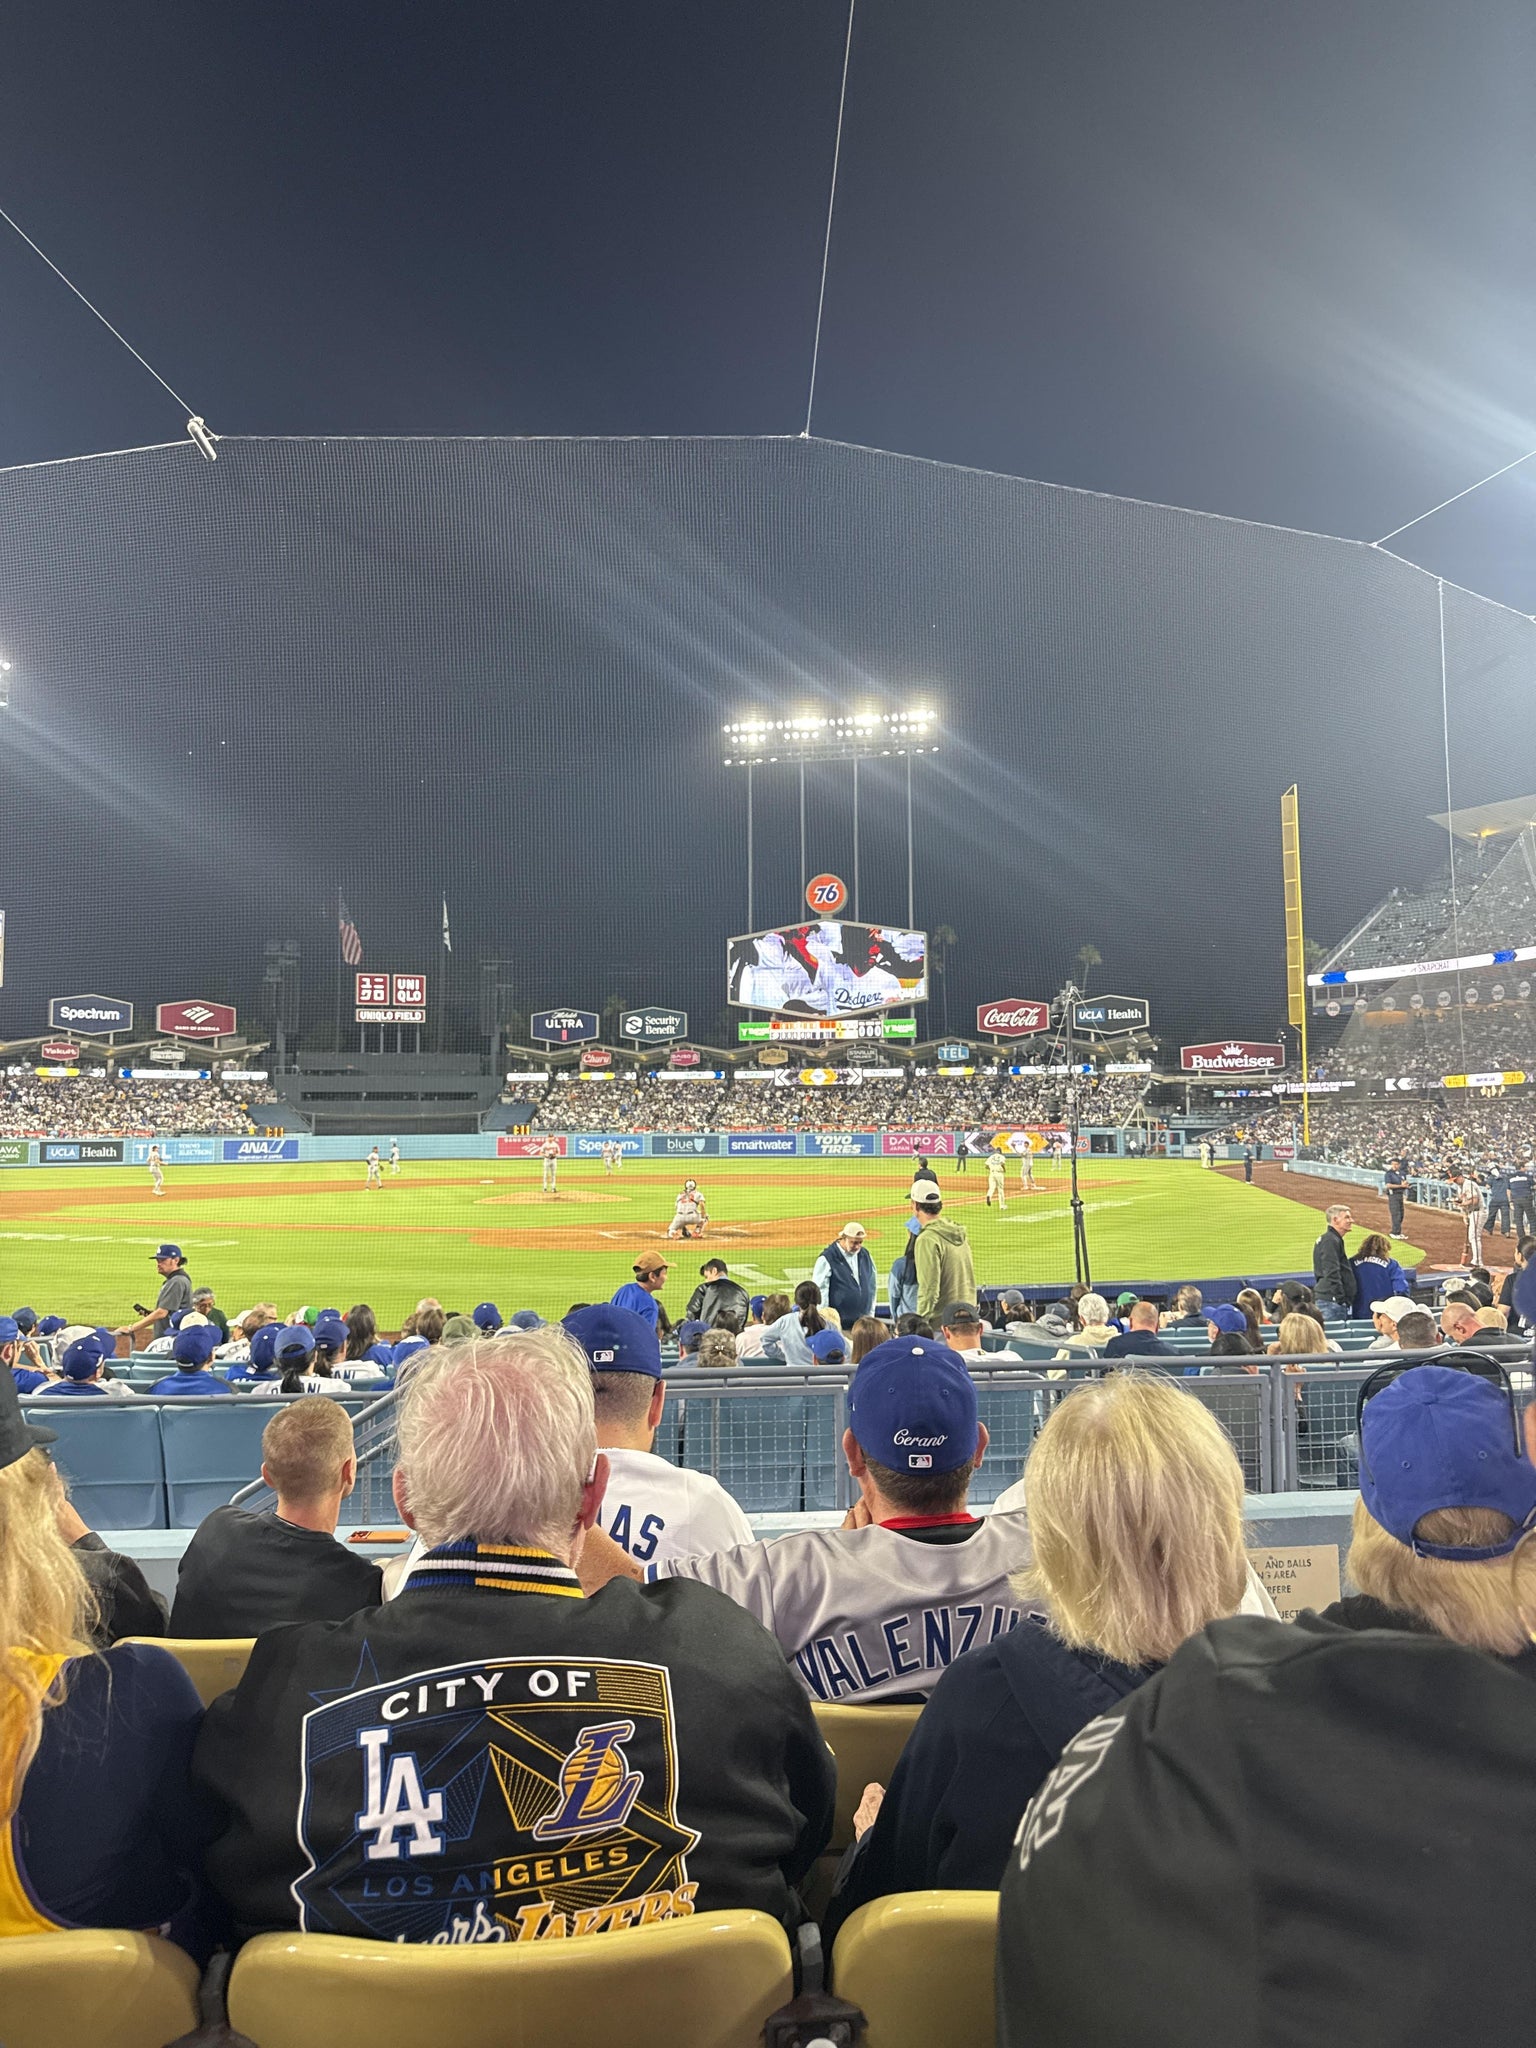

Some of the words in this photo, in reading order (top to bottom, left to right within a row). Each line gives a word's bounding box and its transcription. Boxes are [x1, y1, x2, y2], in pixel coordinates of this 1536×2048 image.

[814, 883, 839, 904] 76
[360, 978, 385, 989] ユニ
[397, 978, 420, 990] UNI
[360, 990, 385, 1001] クロ
[397, 990, 422, 1003] QLO
[60, 1006, 120, 1020] Spectrum
[359, 1011, 394, 1021] UNIQLO
[394, 1011, 422, 1021] FIELD
[1079, 1011, 1103, 1021] UCLA
[1107, 1008, 1142, 1020] Health
[545, 1018, 584, 1029] ULTRA
[645, 1016, 681, 1031] Security
[645, 1027, 676, 1036] Benefit
[583, 1052, 610, 1063] Churu
[941, 1047, 966, 1058] TEL
[1191, 1055, 1276, 1069] Budweiser
[667, 1138, 694, 1150] blue
[731, 1138, 794, 1151] smartwater
[815, 1135, 853, 1145] TOYO
[51, 1148, 76, 1157] UCLA
[82, 1147, 117, 1158] Health
[238, 1141, 268, 1154] ANA
[820, 1144, 862, 1154] TIRES
[893, 1428, 949, 1447] Cerano
[596, 1503, 666, 1562] AS
[1265, 1560, 1284, 1569] AND
[1287, 1558, 1312, 1568] BALLS
[1274, 1570, 1297, 1579] AREA
[381, 1672, 503, 1720] CITY
[528, 1670, 592, 1698] OF
[357, 1727, 448, 1858] LA
[363, 1875, 433, 1898] LOS
[450, 1851, 629, 1896] ANGELES
